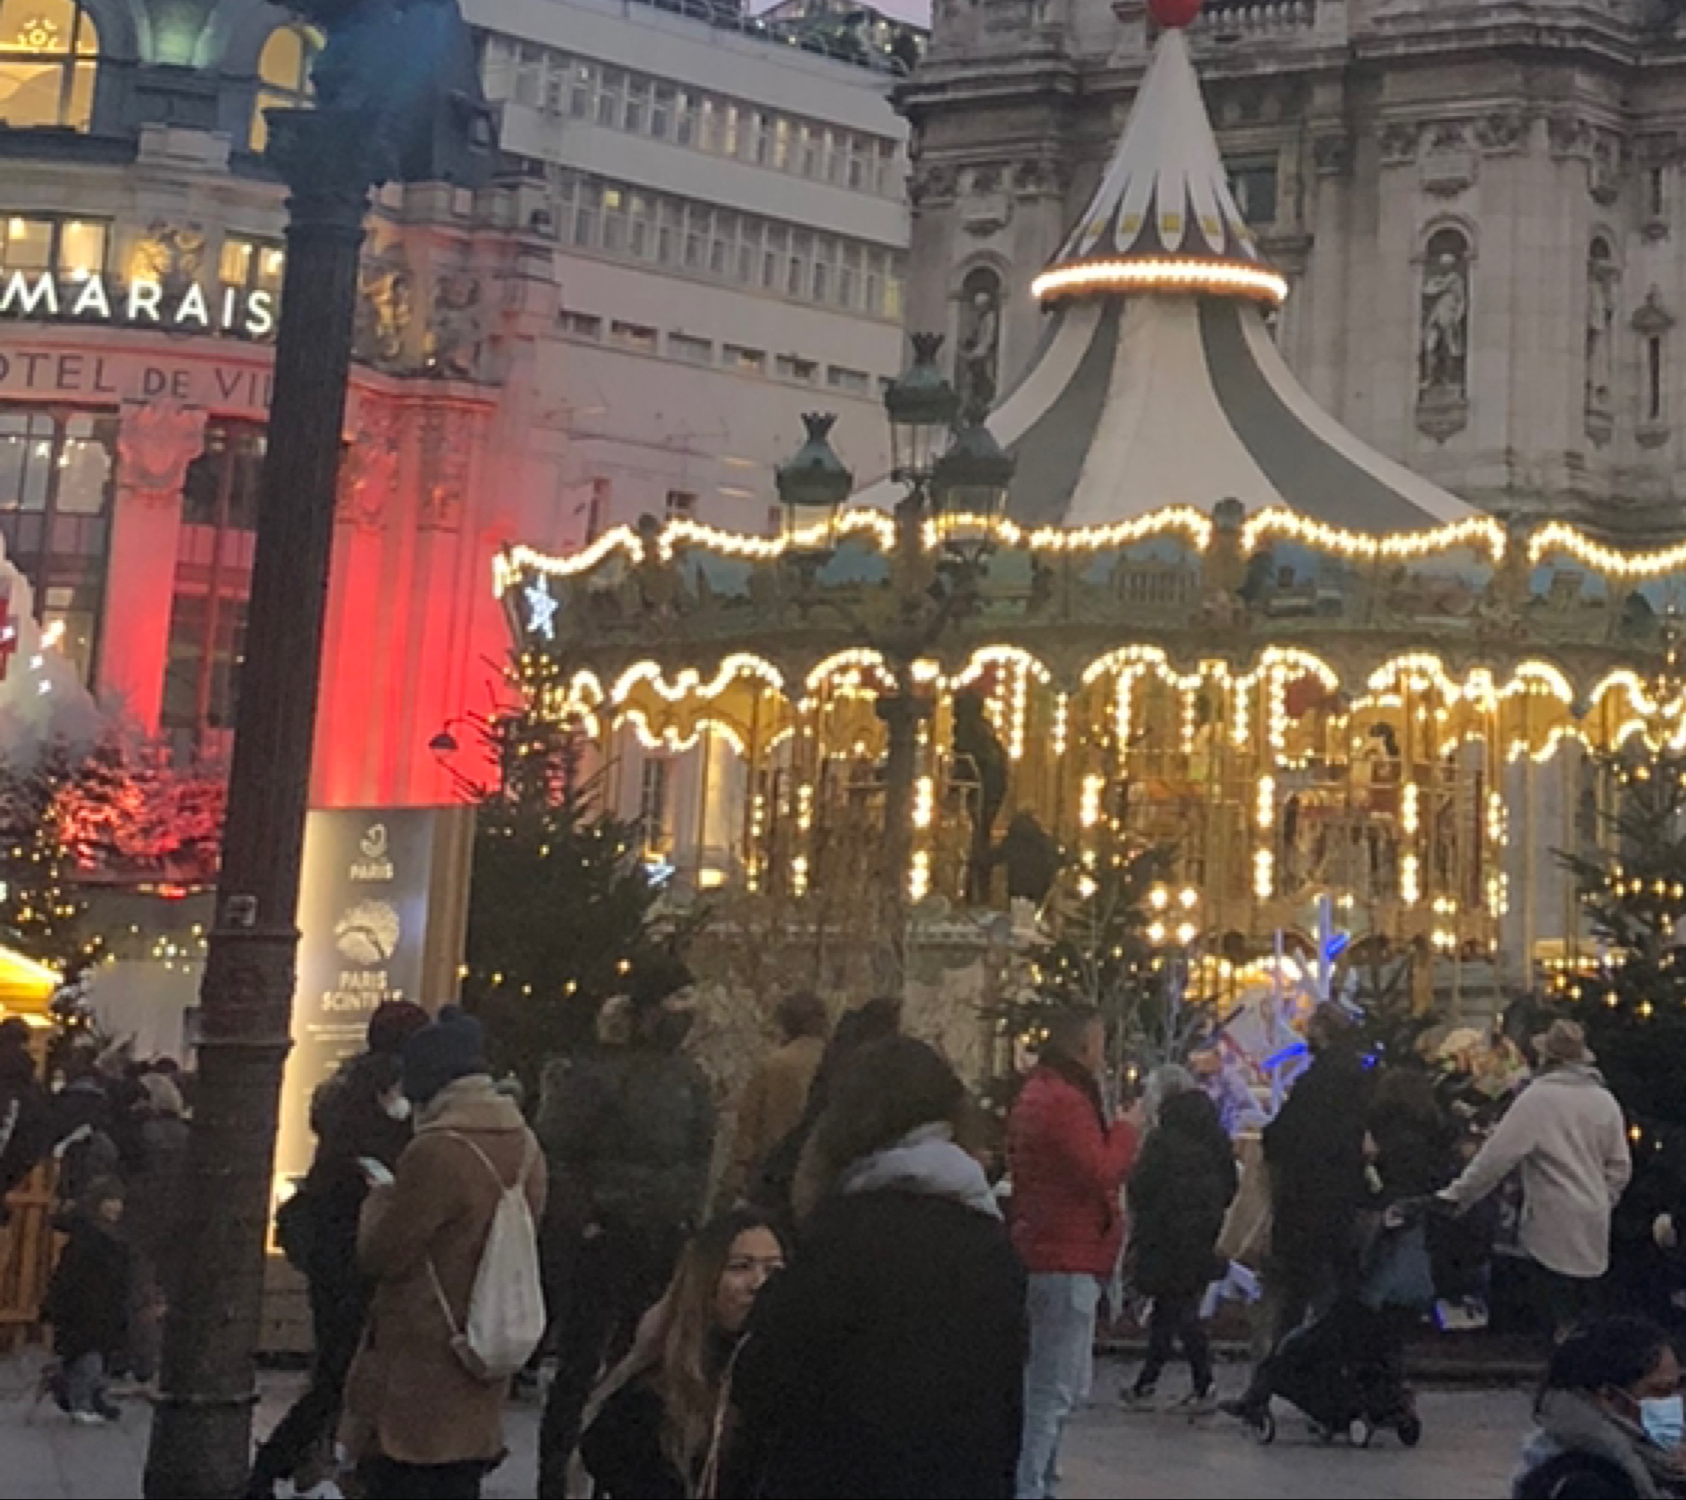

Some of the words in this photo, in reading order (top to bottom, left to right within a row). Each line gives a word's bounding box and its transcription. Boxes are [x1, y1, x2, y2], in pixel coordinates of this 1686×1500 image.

[0, 269, 273, 333] MARAIS
[0, 352, 117, 392] TEL
[143, 368, 190, 399] DE
[350, 862, 394, 880] PARIS
[340, 970, 388, 990] PARIS
